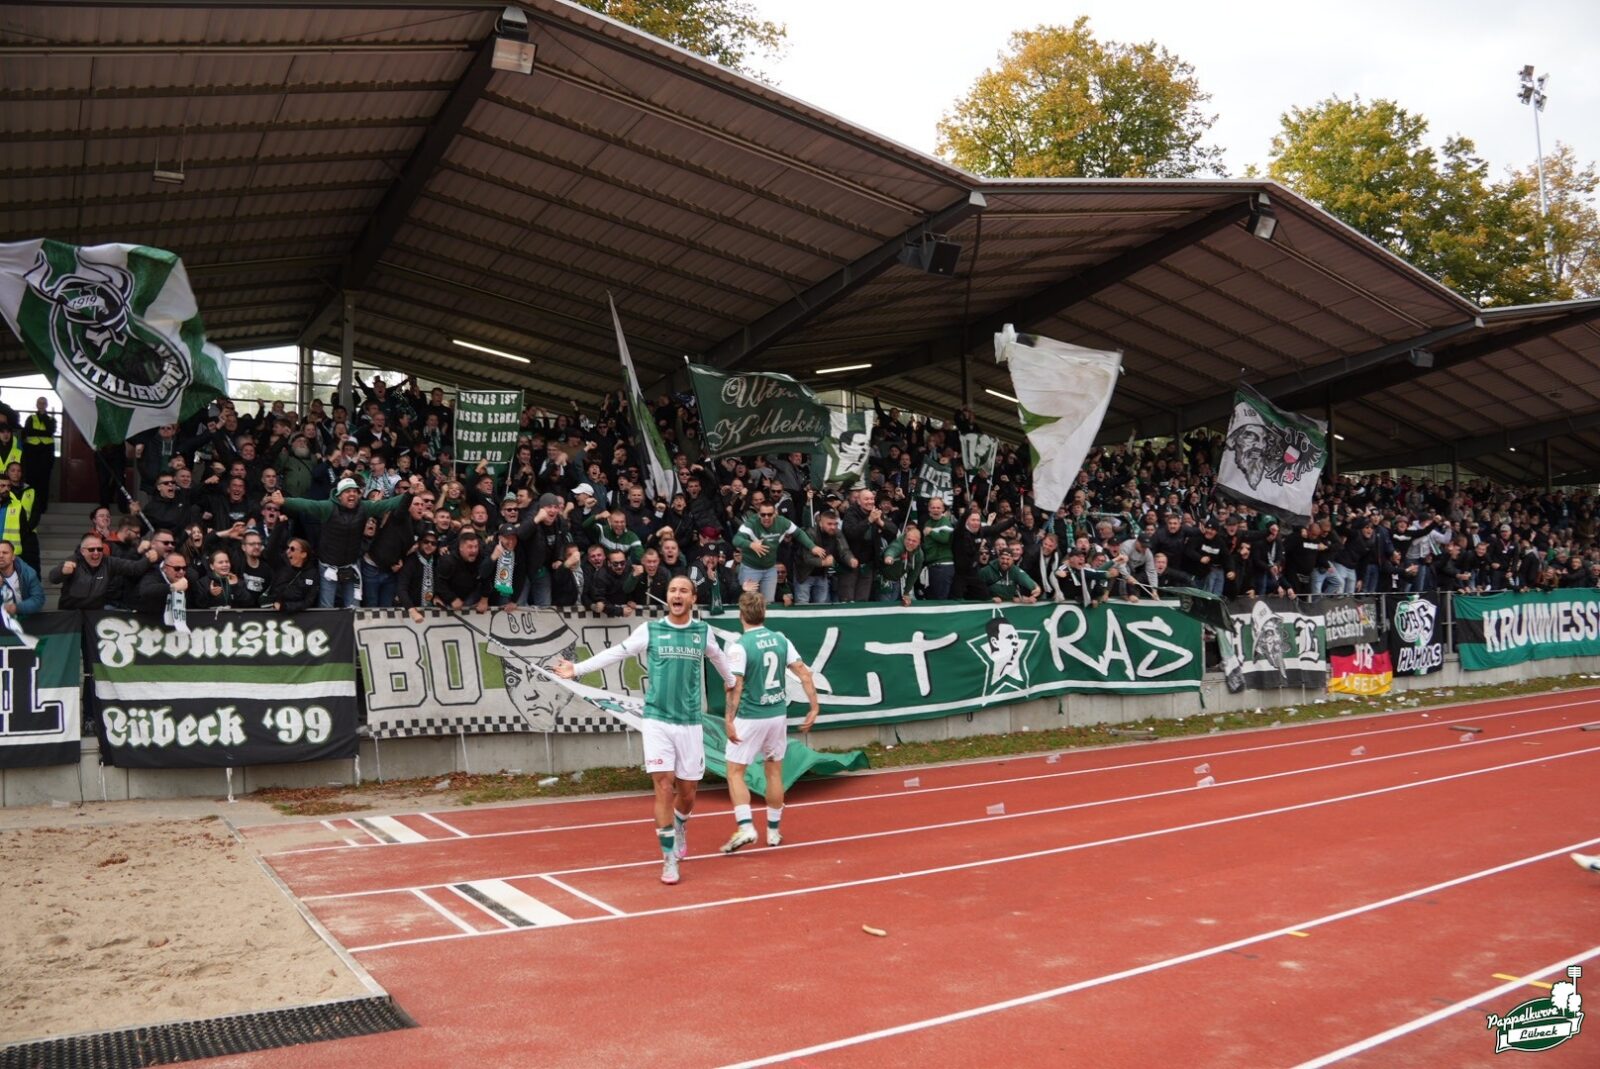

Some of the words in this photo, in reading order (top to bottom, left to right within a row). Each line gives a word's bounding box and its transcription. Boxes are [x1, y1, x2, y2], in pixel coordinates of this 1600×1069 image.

[72, 295, 98, 309] 1919
[500, 394, 518, 405] IST
[1481, 600, 1600, 653] KRUMMESS
[658, 645, 674, 654] BTR
[675, 646, 702, 656] SUMUS
[763, 651, 780, 690] 2
[103, 706, 247, 747] Lübeck
